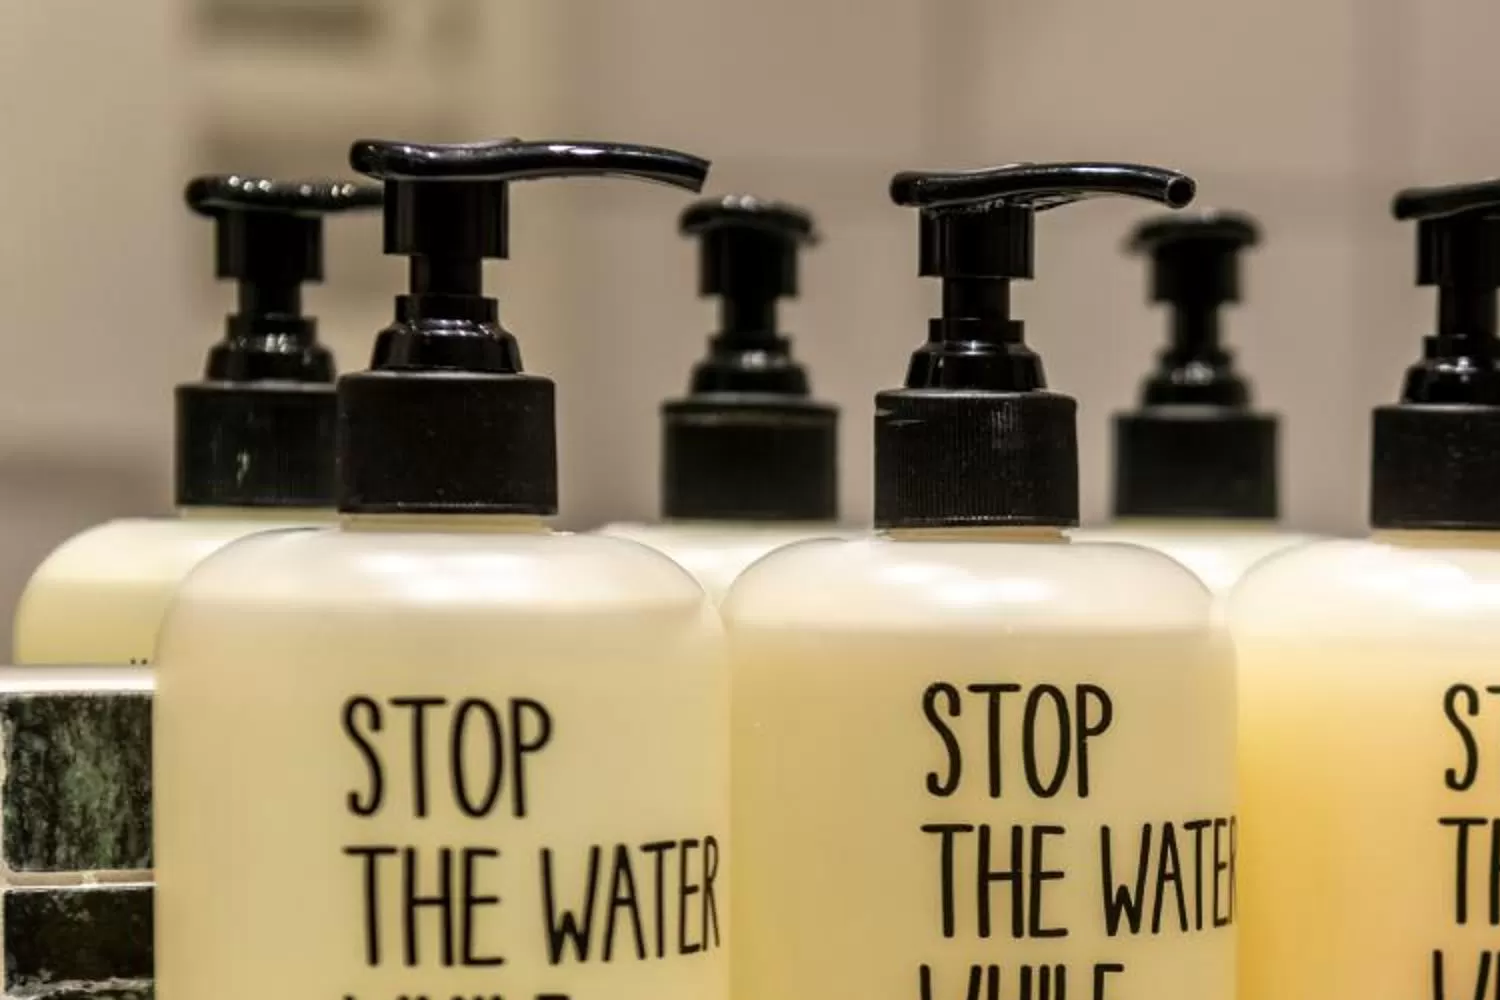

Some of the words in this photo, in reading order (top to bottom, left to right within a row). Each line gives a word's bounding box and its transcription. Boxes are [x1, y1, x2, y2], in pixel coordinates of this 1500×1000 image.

[341, 696, 553, 818] STOP
[922, 682, 1113, 798] STOP
[343, 846, 505, 967] THE
[540, 835, 720, 965] WATER
[920, 824, 1068, 938] THE
